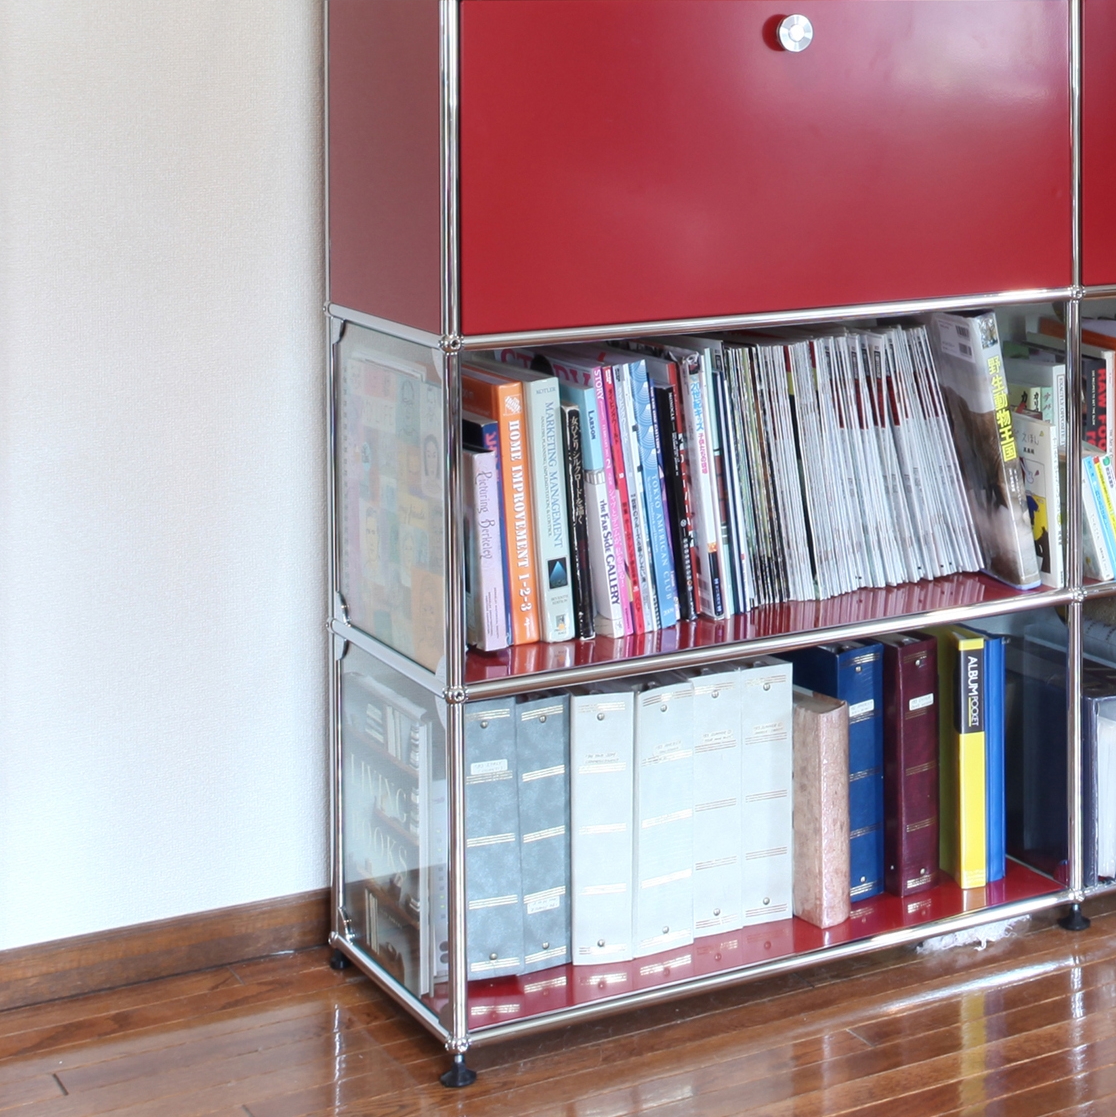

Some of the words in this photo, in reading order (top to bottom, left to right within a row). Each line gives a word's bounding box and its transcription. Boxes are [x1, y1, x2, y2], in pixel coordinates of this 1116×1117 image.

[594, 369, 604, 400] STORY
[987, 356, 1018, 462] 野生動物王国
[508, 420, 523, 461] HOME
[545, 402, 557, 468] MARKETING
[1098, 414, 1106, 451] FOO
[475, 470, 492, 515] Picturing
[549, 471, 563, 548] MANAGEMENT
[651, 475, 661, 509] TOKYO
[481, 518, 495, 561] Berkeley
[511, 465, 530, 569] IMPROVEMENT
[655, 513, 668, 567] AMERICAN
[518, 573, 533, 613] 1-2-3
[607, 555, 621, 605] GALLERY
[663, 570, 672, 601] CLUB
[350, 753, 407, 825] LIVING
